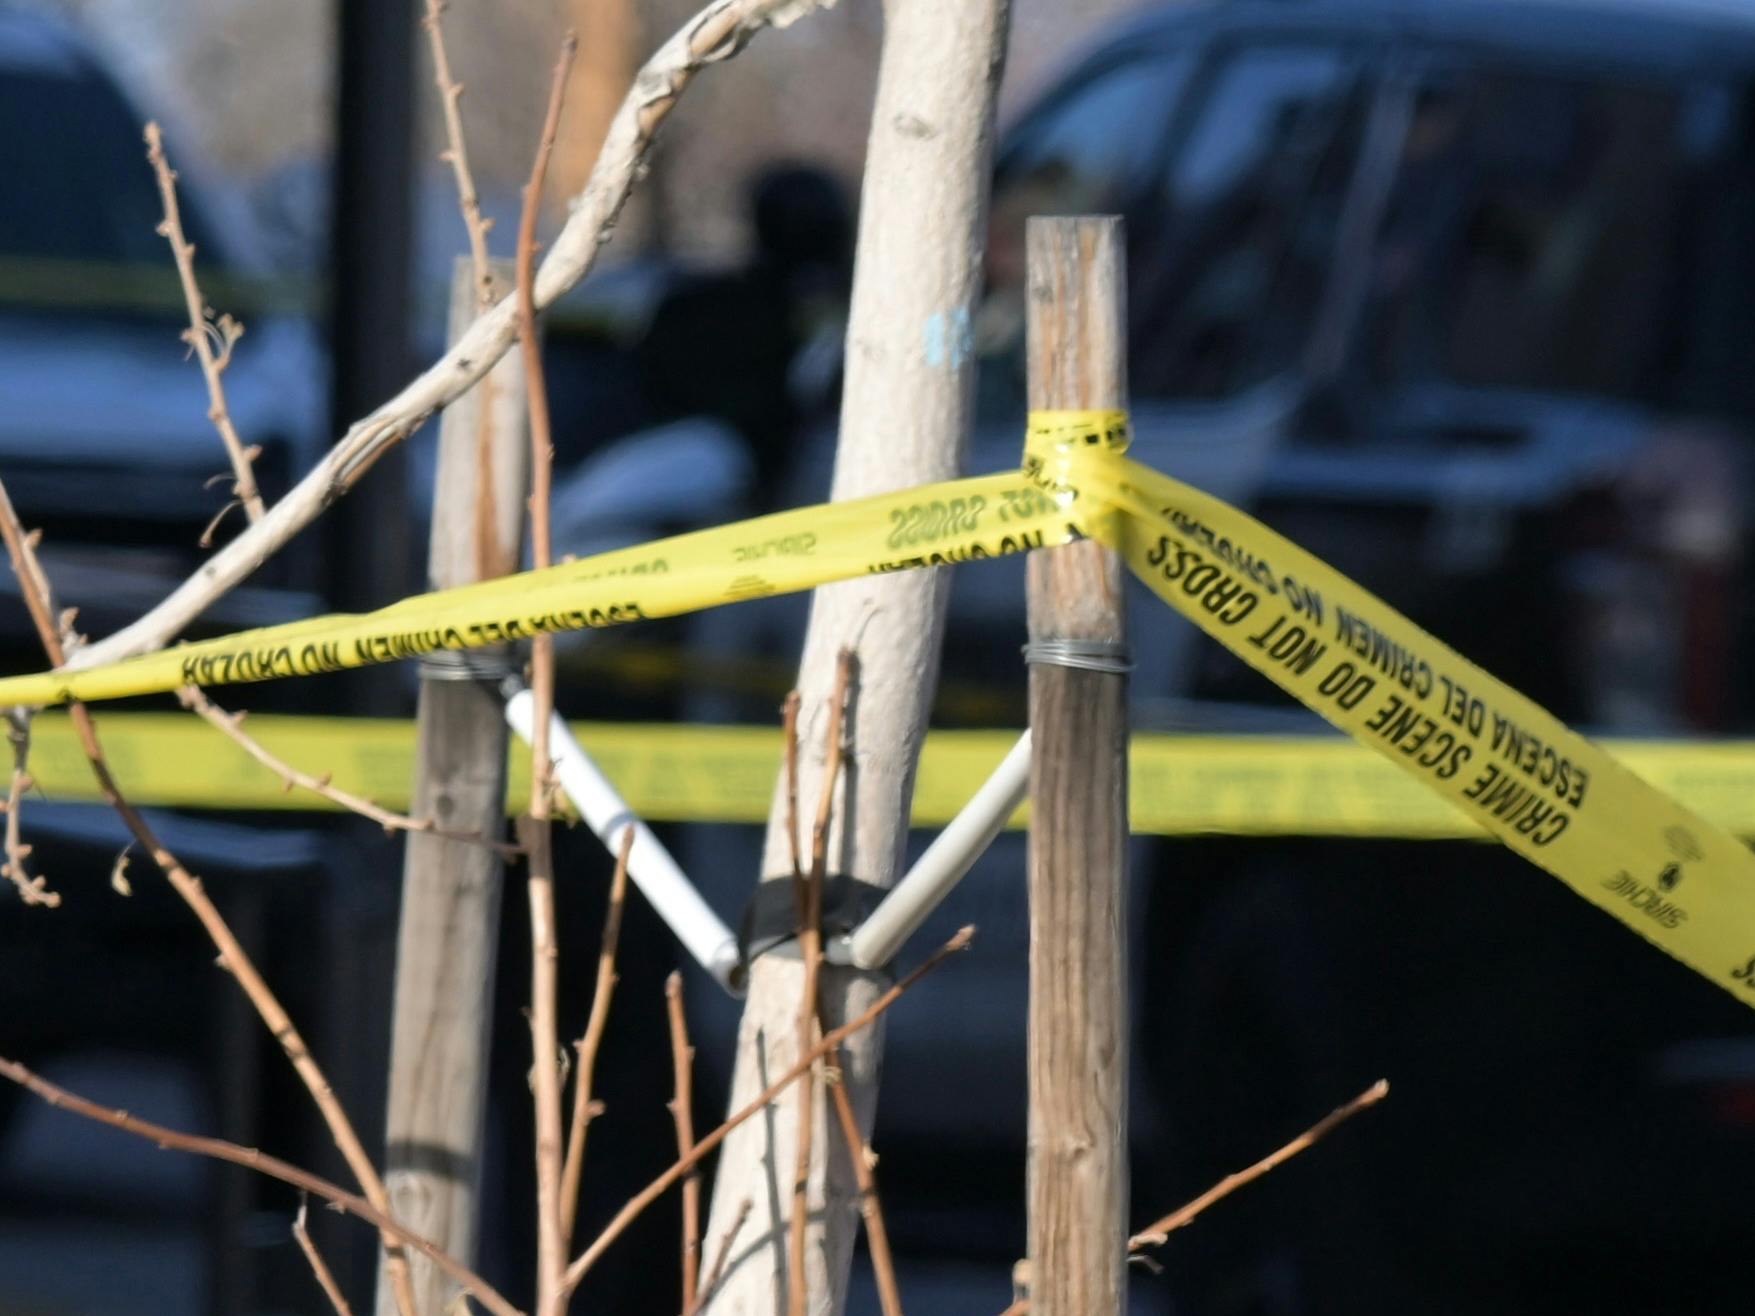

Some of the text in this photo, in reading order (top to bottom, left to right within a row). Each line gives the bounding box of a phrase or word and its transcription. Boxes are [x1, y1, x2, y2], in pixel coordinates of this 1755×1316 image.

[1146, 535, 1258, 625] CROSS
[1286, 574, 1325, 626] NO
[1247, 615, 1327, 675] NOT
[1335, 604, 1435, 700] CRIMEN
[1316, 660, 1376, 711] DO
[1439, 675, 1486, 738] DEL
[1365, 694, 1472, 779] SCENE
[1491, 711, 1589, 808] ESCENA
[1463, 763, 1569, 846] CRIME
[1601, 869, 1688, 929] SIRCHIE
